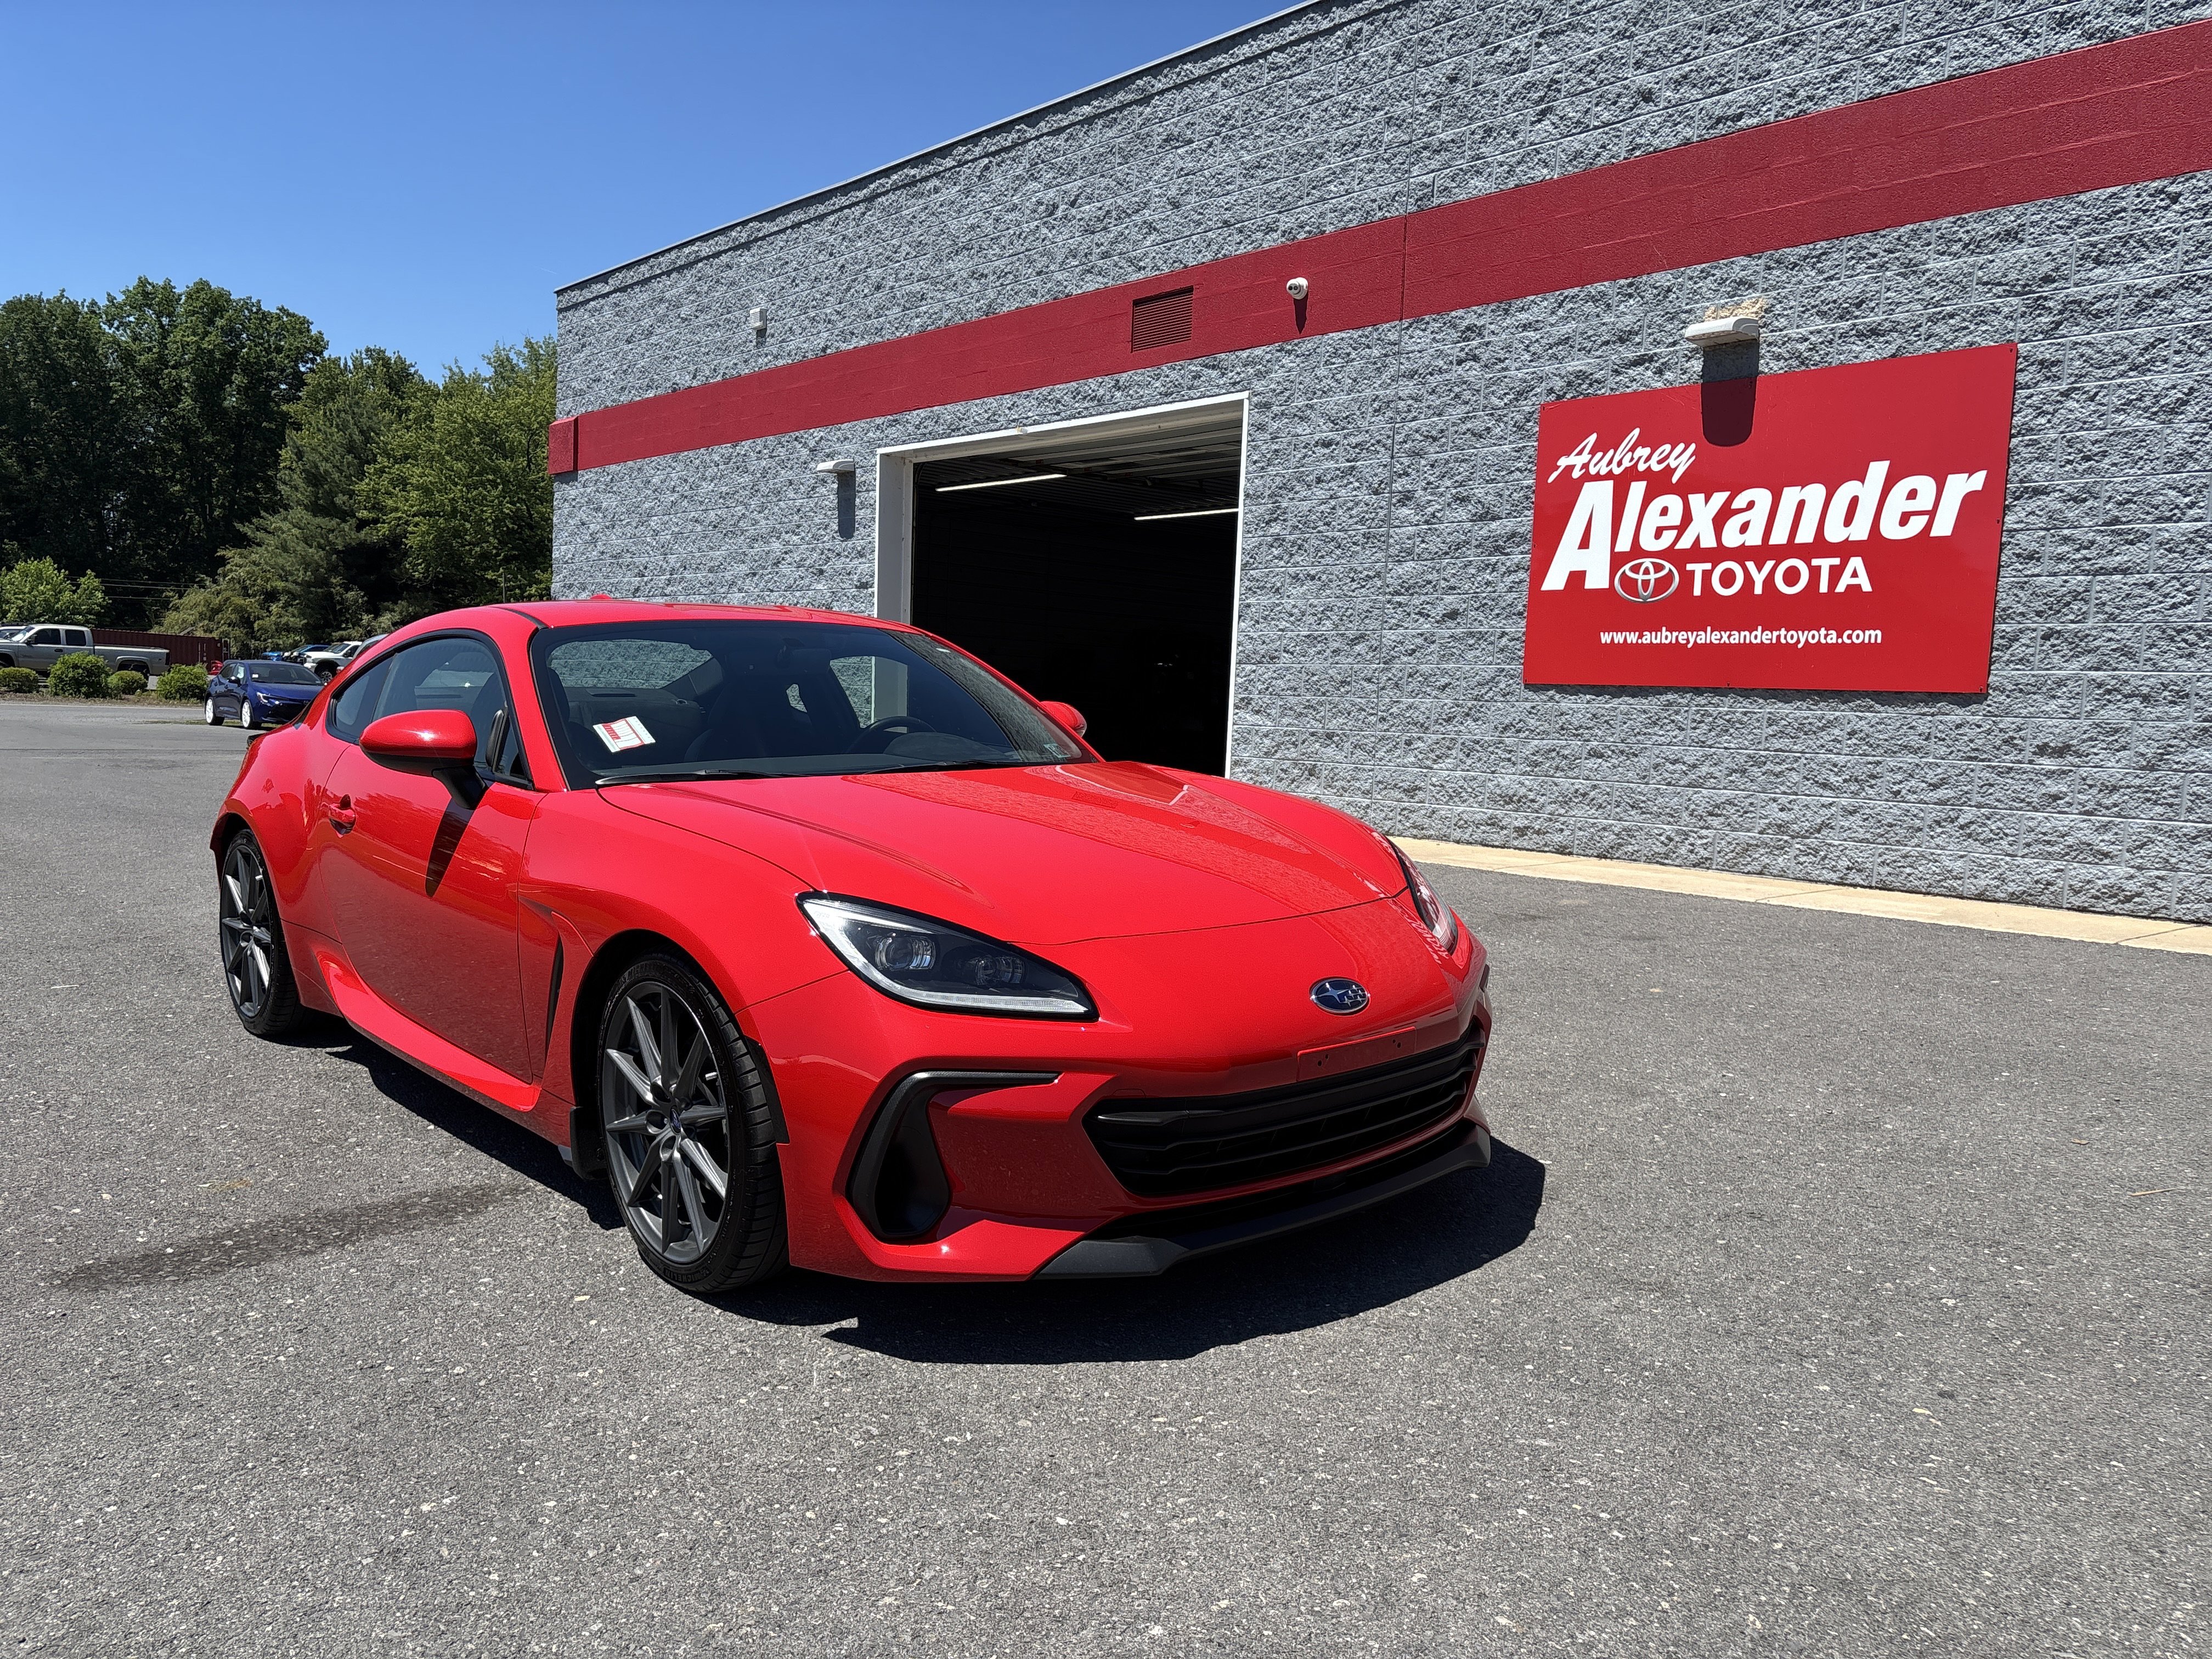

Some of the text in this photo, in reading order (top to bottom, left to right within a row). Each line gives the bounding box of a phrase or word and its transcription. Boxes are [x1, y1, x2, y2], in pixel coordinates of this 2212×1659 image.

[1548, 428, 1696, 484] Aubrey
[1541, 460, 1987, 591] Alexander
[1686, 557, 1873, 596] TOYOTA
[1600, 626, 1882, 648] www.aubreyalexandertoyota.com
